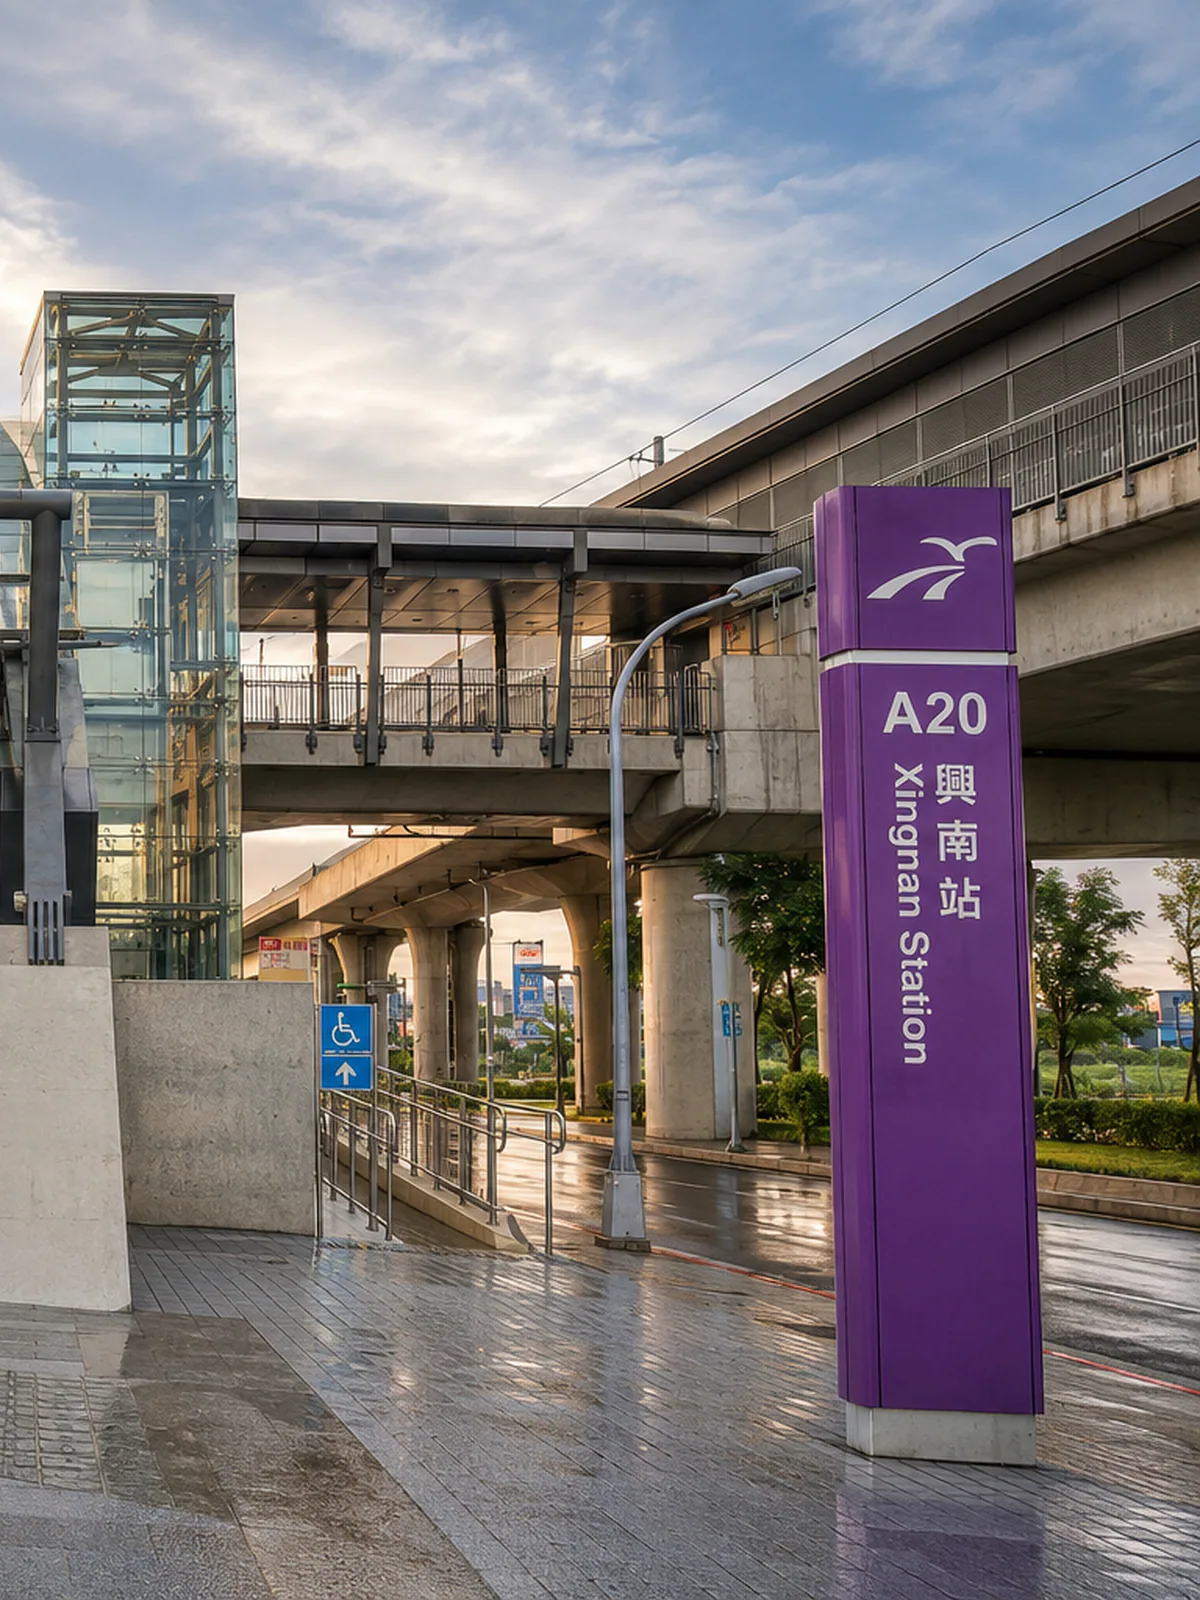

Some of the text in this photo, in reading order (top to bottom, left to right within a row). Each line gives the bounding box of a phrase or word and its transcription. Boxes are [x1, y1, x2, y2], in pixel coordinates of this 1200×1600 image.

[883, 691, 987, 735] A20
[888, 763, 932, 1064] Xingnan Station
[935, 763, 981, 919] 興南站
